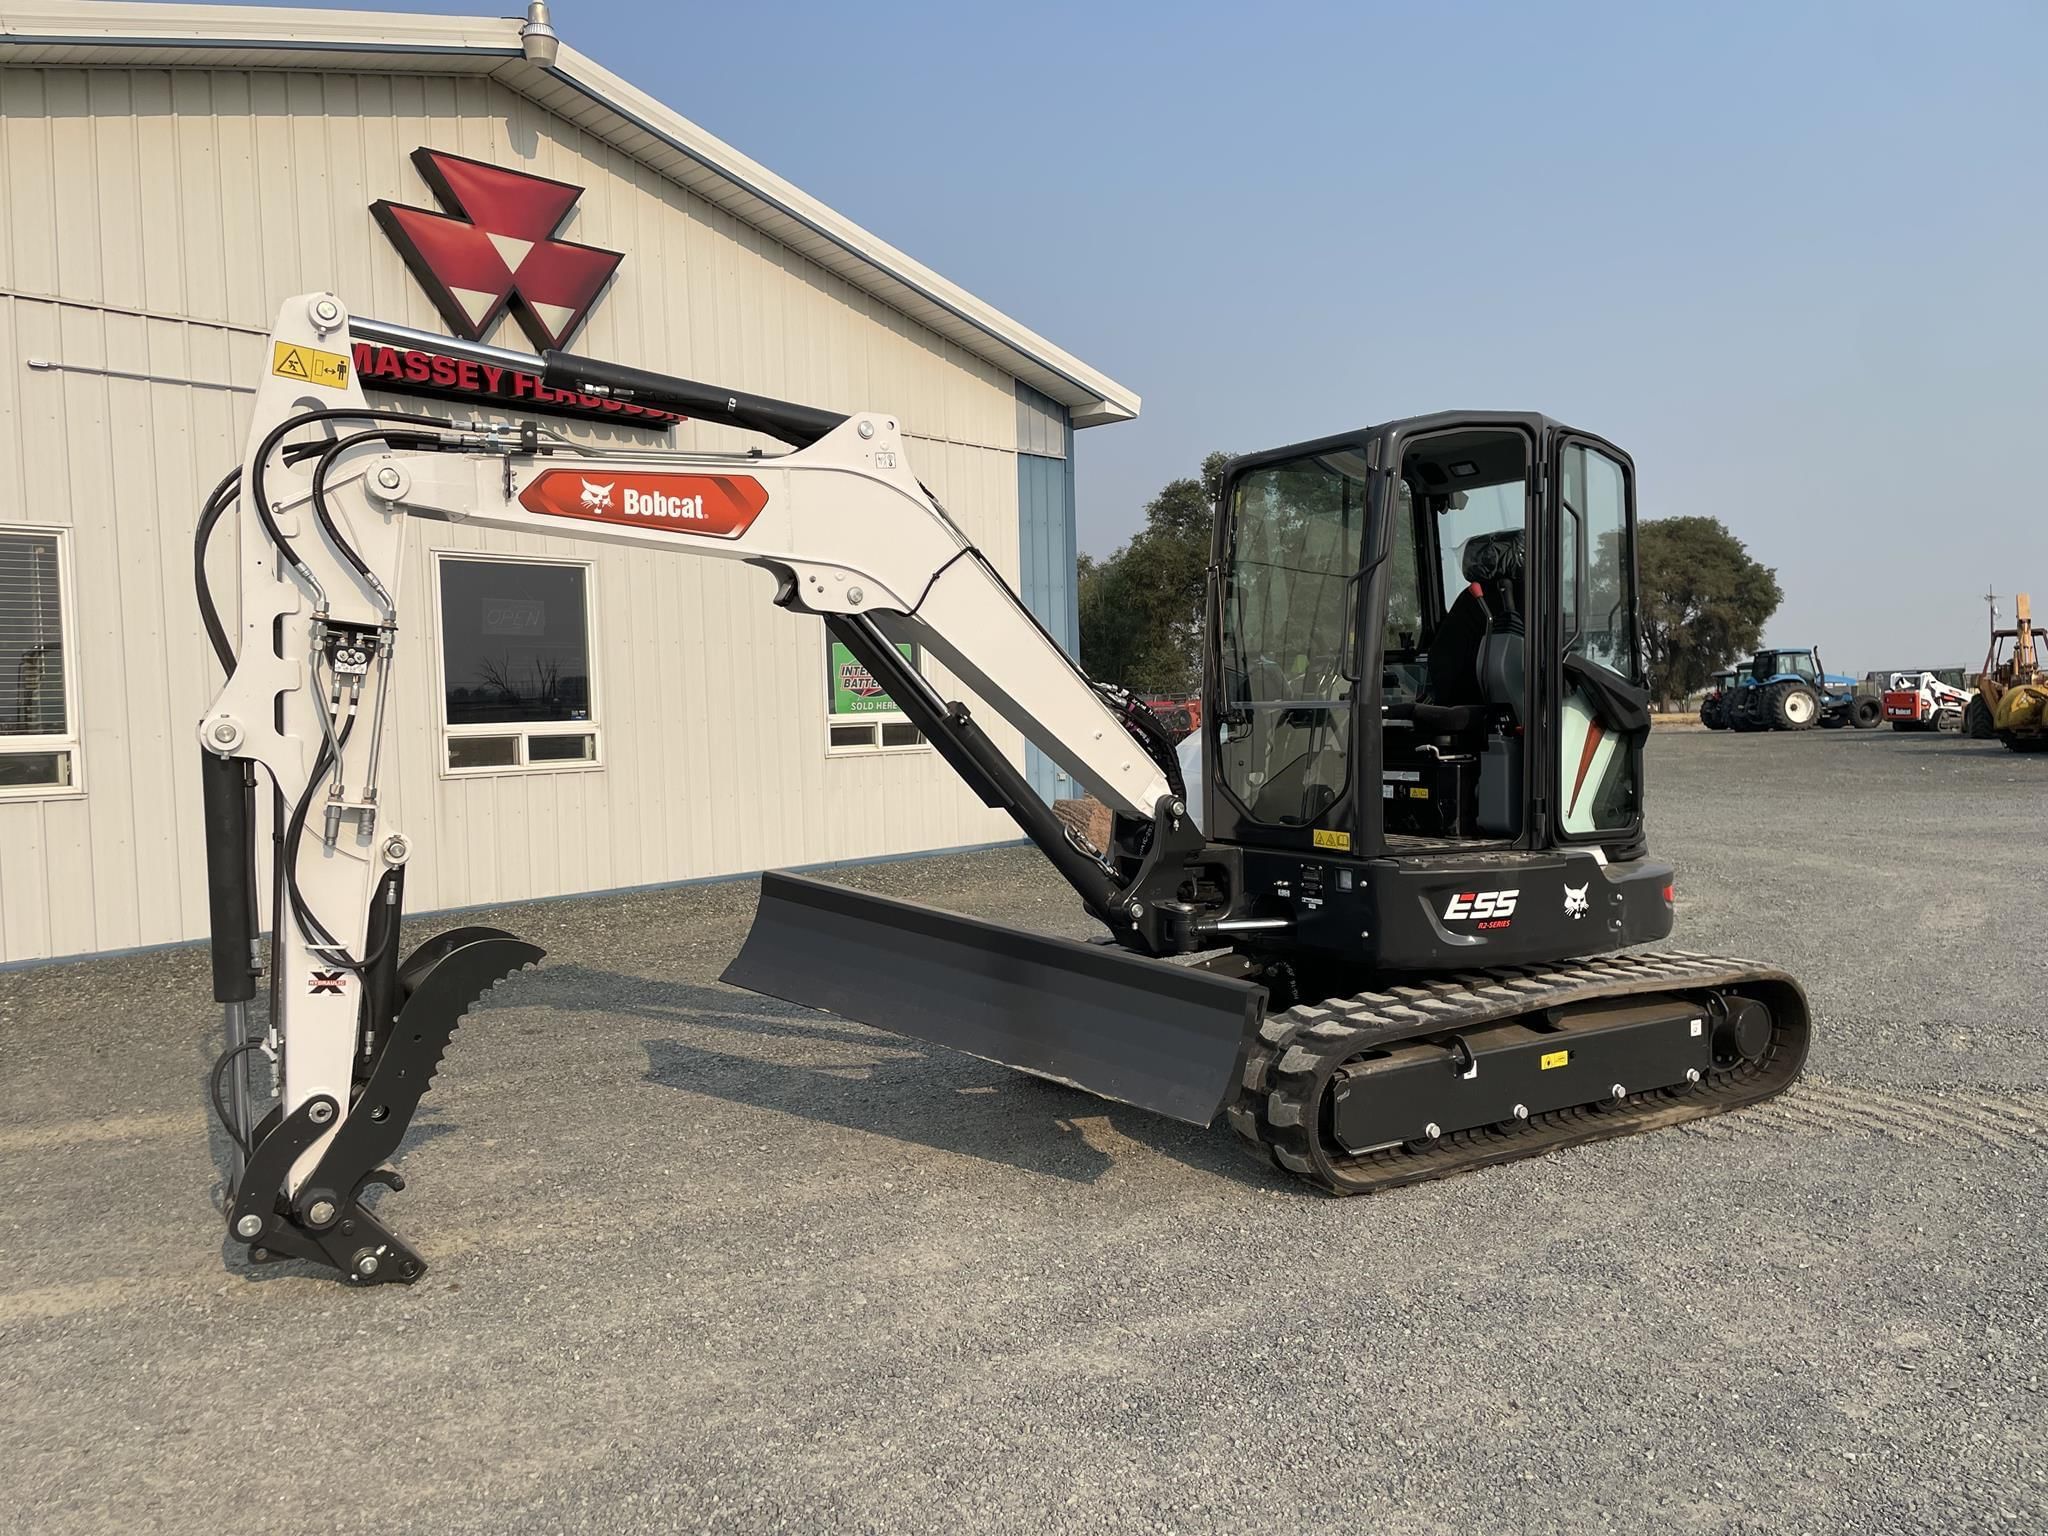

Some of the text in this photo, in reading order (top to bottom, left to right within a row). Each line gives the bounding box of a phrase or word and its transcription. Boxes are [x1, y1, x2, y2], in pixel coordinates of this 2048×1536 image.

[354, 343, 505, 393] MASSEY
[623, 488, 704, 519] Bobcat
[487, 609, 540, 626] OPEN
[851, 702, 874, 710] SOLD
[1443, 889, 1520, 920] E55
[1477, 920, 1511, 929] R2-SERIES
